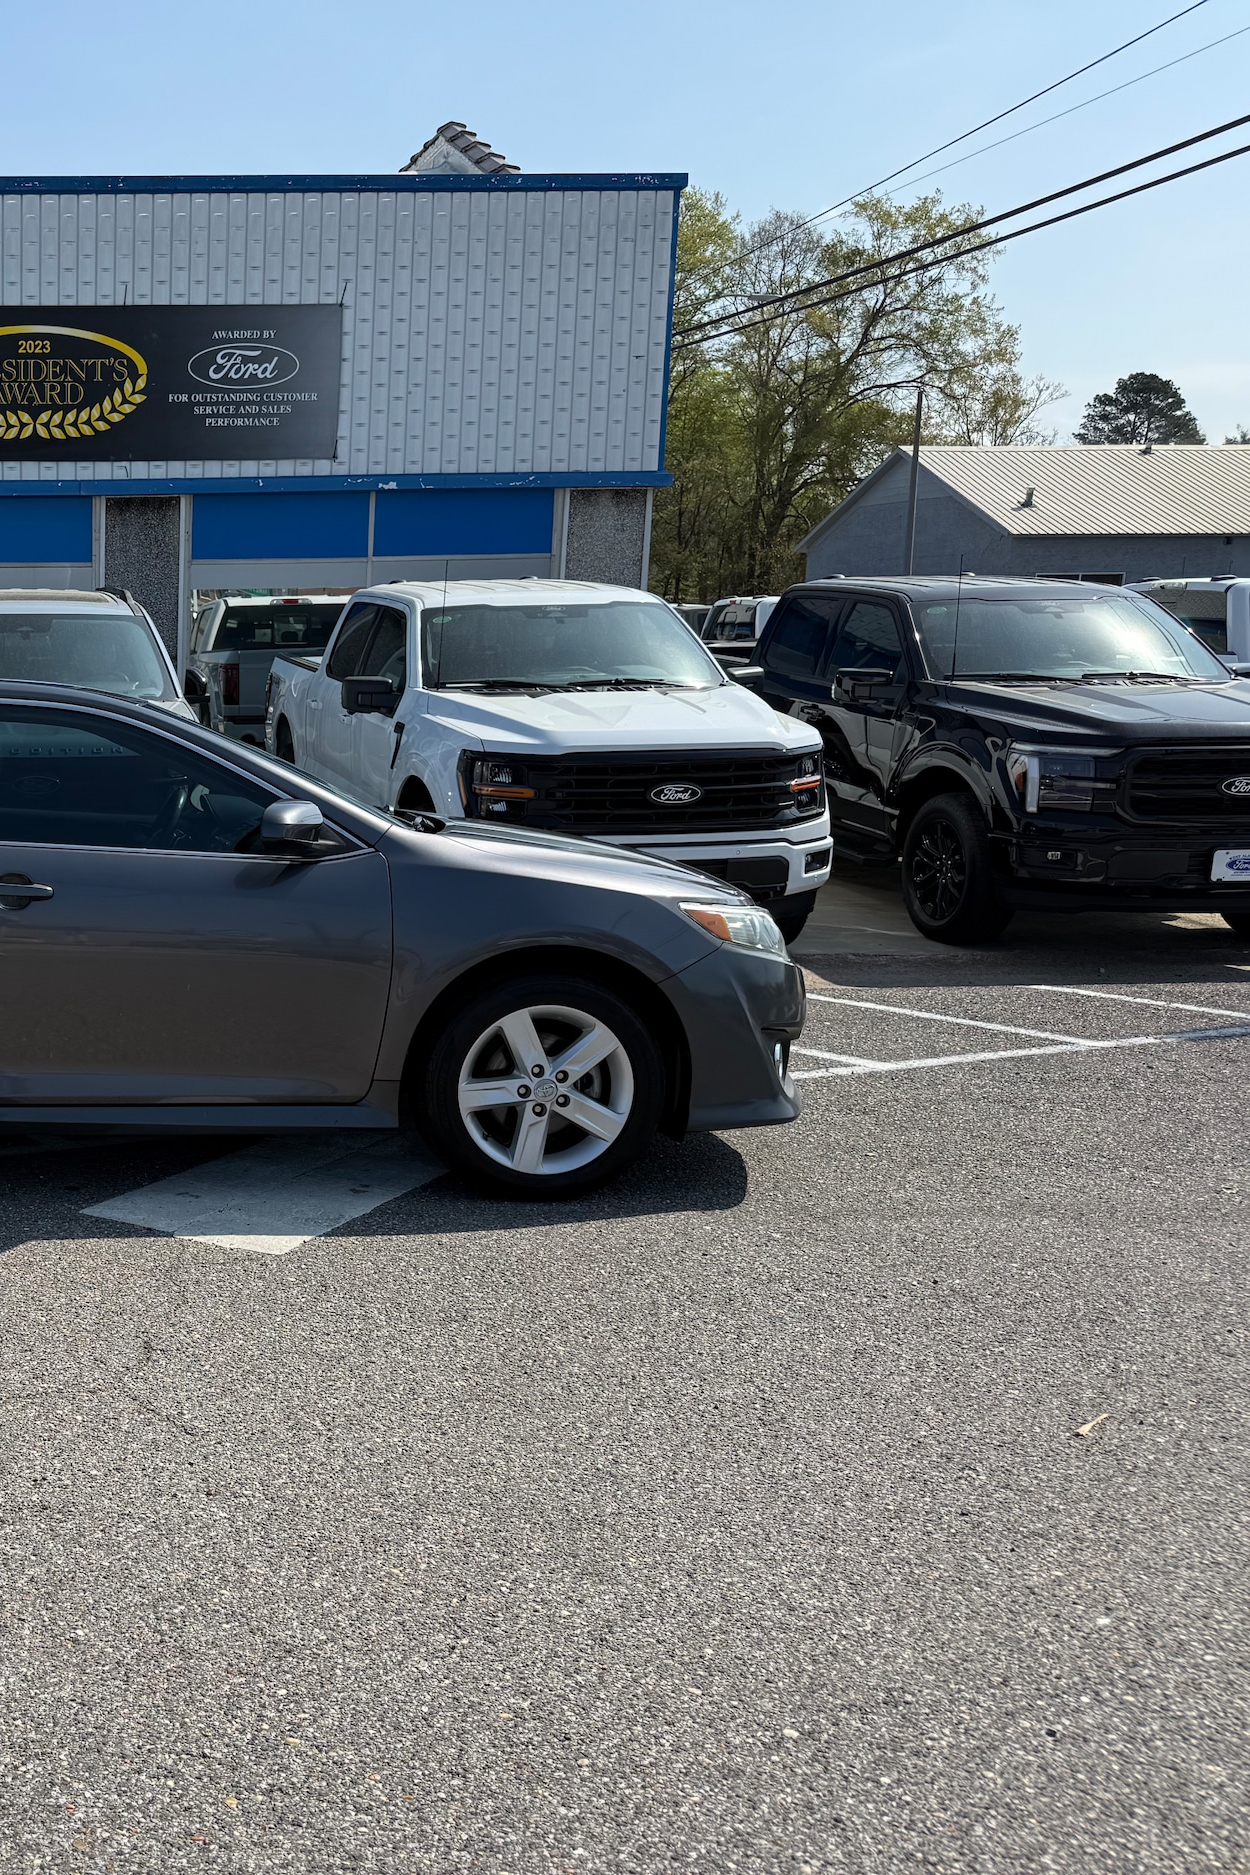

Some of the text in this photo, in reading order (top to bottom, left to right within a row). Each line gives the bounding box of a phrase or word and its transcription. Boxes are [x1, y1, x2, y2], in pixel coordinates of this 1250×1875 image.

[212, 330, 277, 339] AWARDED BY
[18, 340, 51, 354] 2023
[209, 349, 279, 379] Ford
[168, 392, 318, 402] FOR OUTSTANDING CUSTOMER
[193, 405, 292, 415] SERVICE AND SALES
[205, 417, 280, 427] PERFORMANCE
[661, 788, 692, 800] Ford
